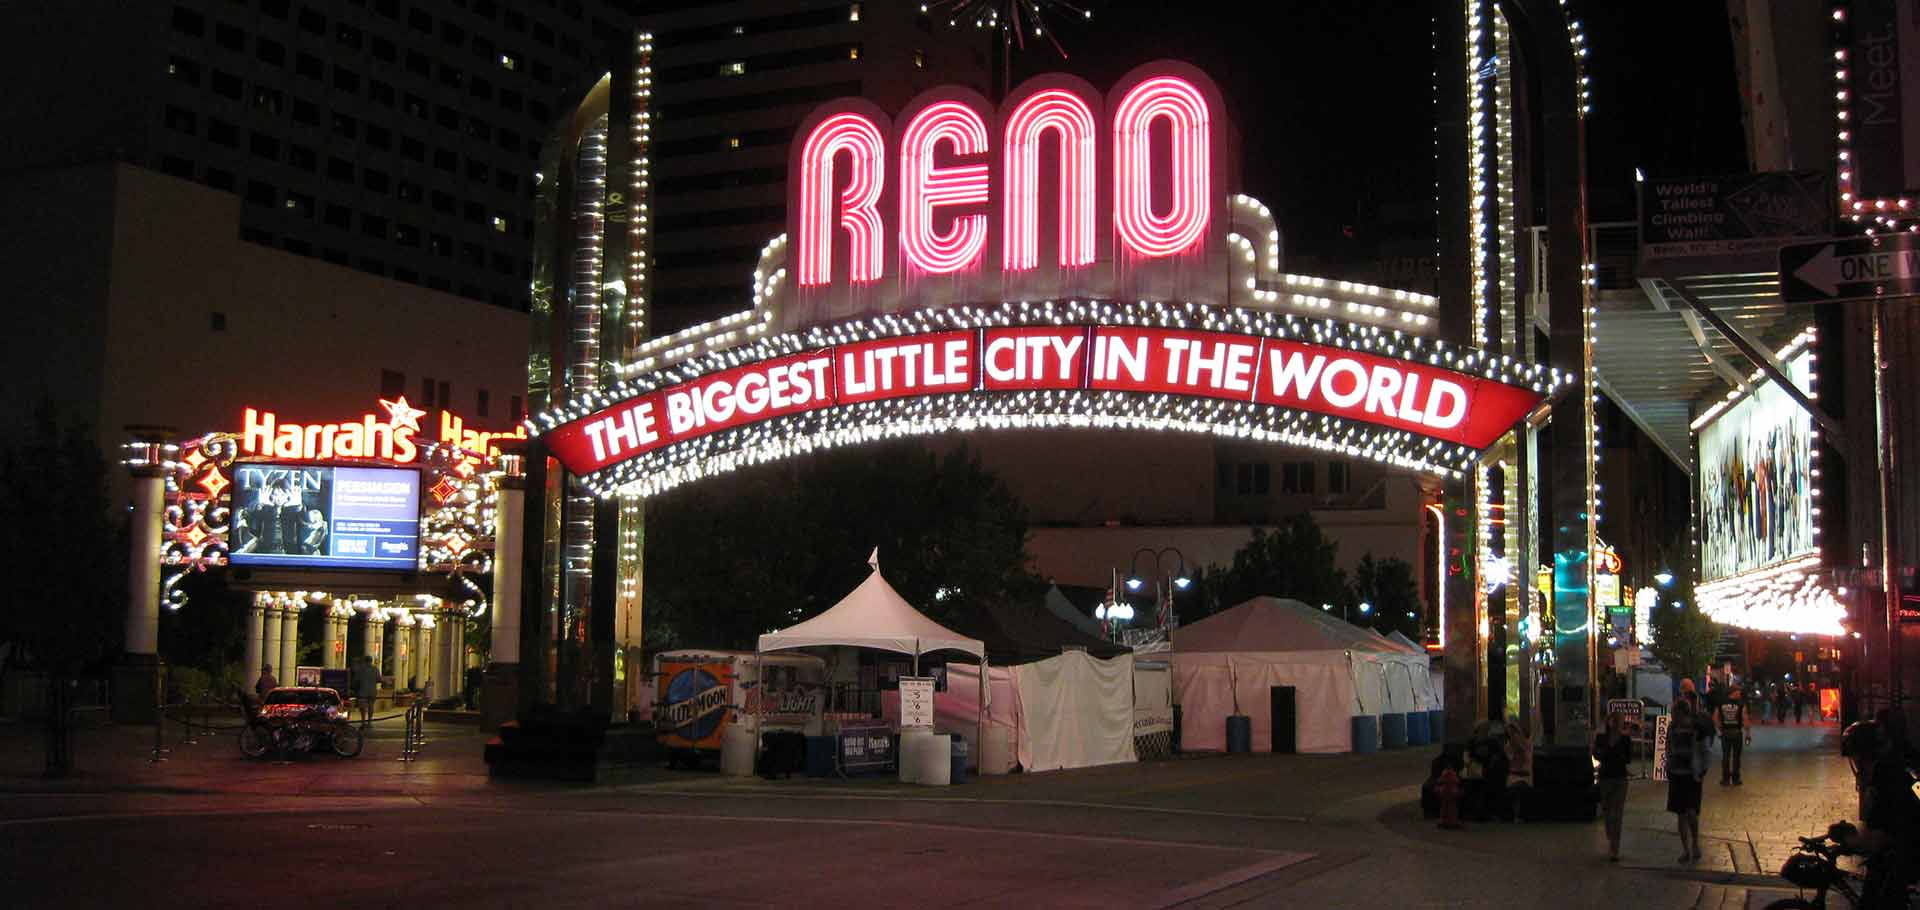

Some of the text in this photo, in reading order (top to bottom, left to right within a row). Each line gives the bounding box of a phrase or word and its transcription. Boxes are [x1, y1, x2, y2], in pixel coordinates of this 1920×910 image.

[799, 76, 1210, 285] RENO
[1661, 197, 1714, 210] Tallest
[1650, 212, 1725, 226] Climbing
[1841, 255, 1889, 281] ONE
[583, 335, 1468, 462] THE BIGGEST LITTLE CITY IN THE WORLD
